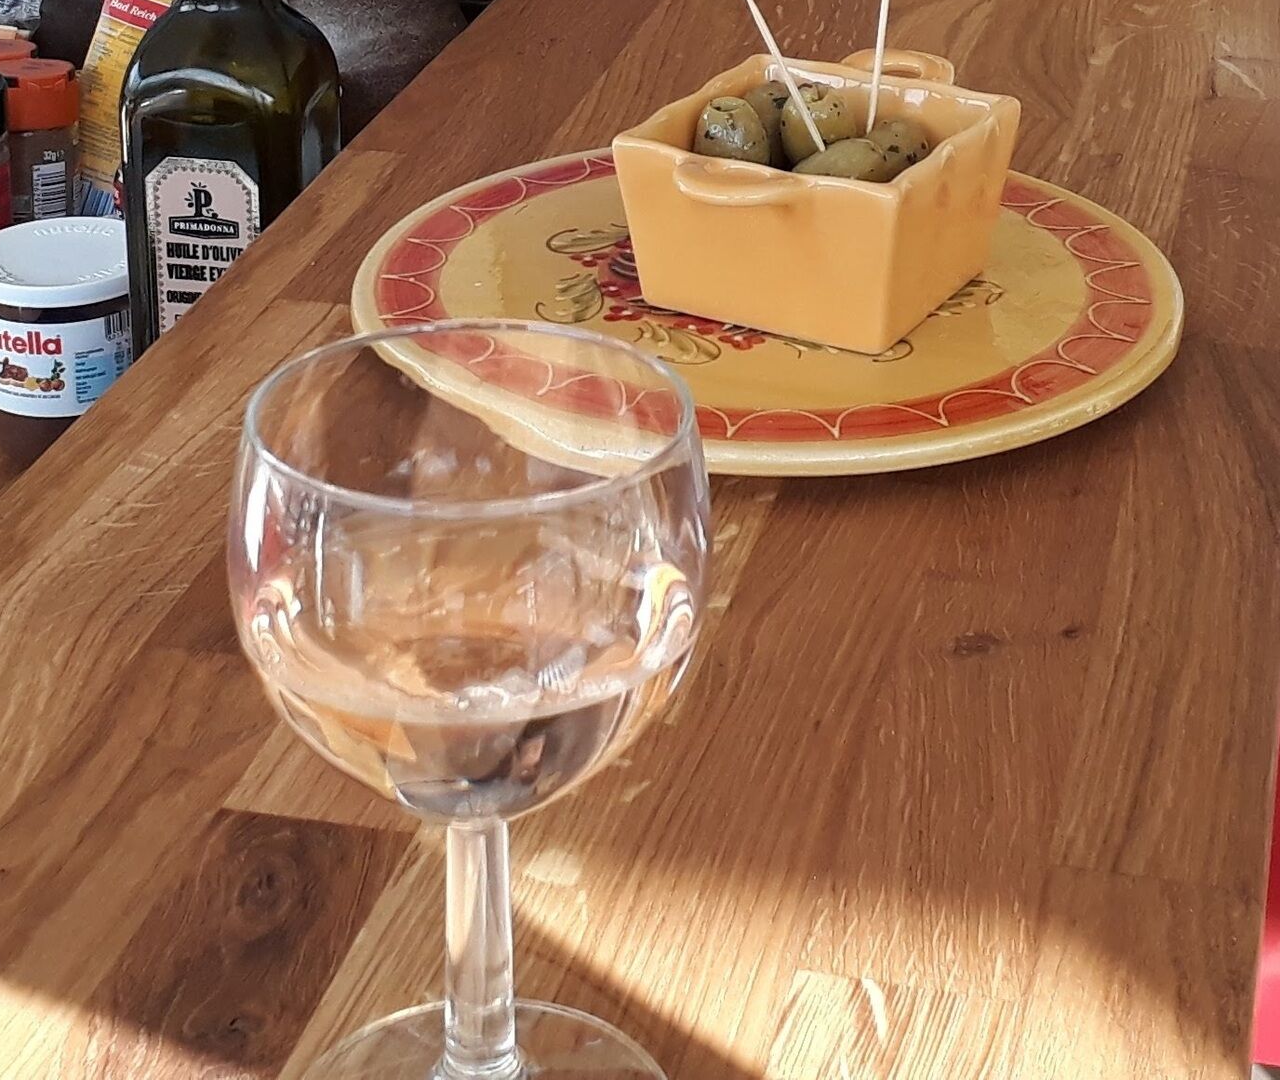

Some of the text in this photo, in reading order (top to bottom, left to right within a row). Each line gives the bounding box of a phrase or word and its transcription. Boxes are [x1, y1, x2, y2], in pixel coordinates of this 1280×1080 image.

[174, 222, 235, 234] PRIMADONNA
[166, 242, 199, 259] HUILE
[167, 263, 207, 281] VIERGE
